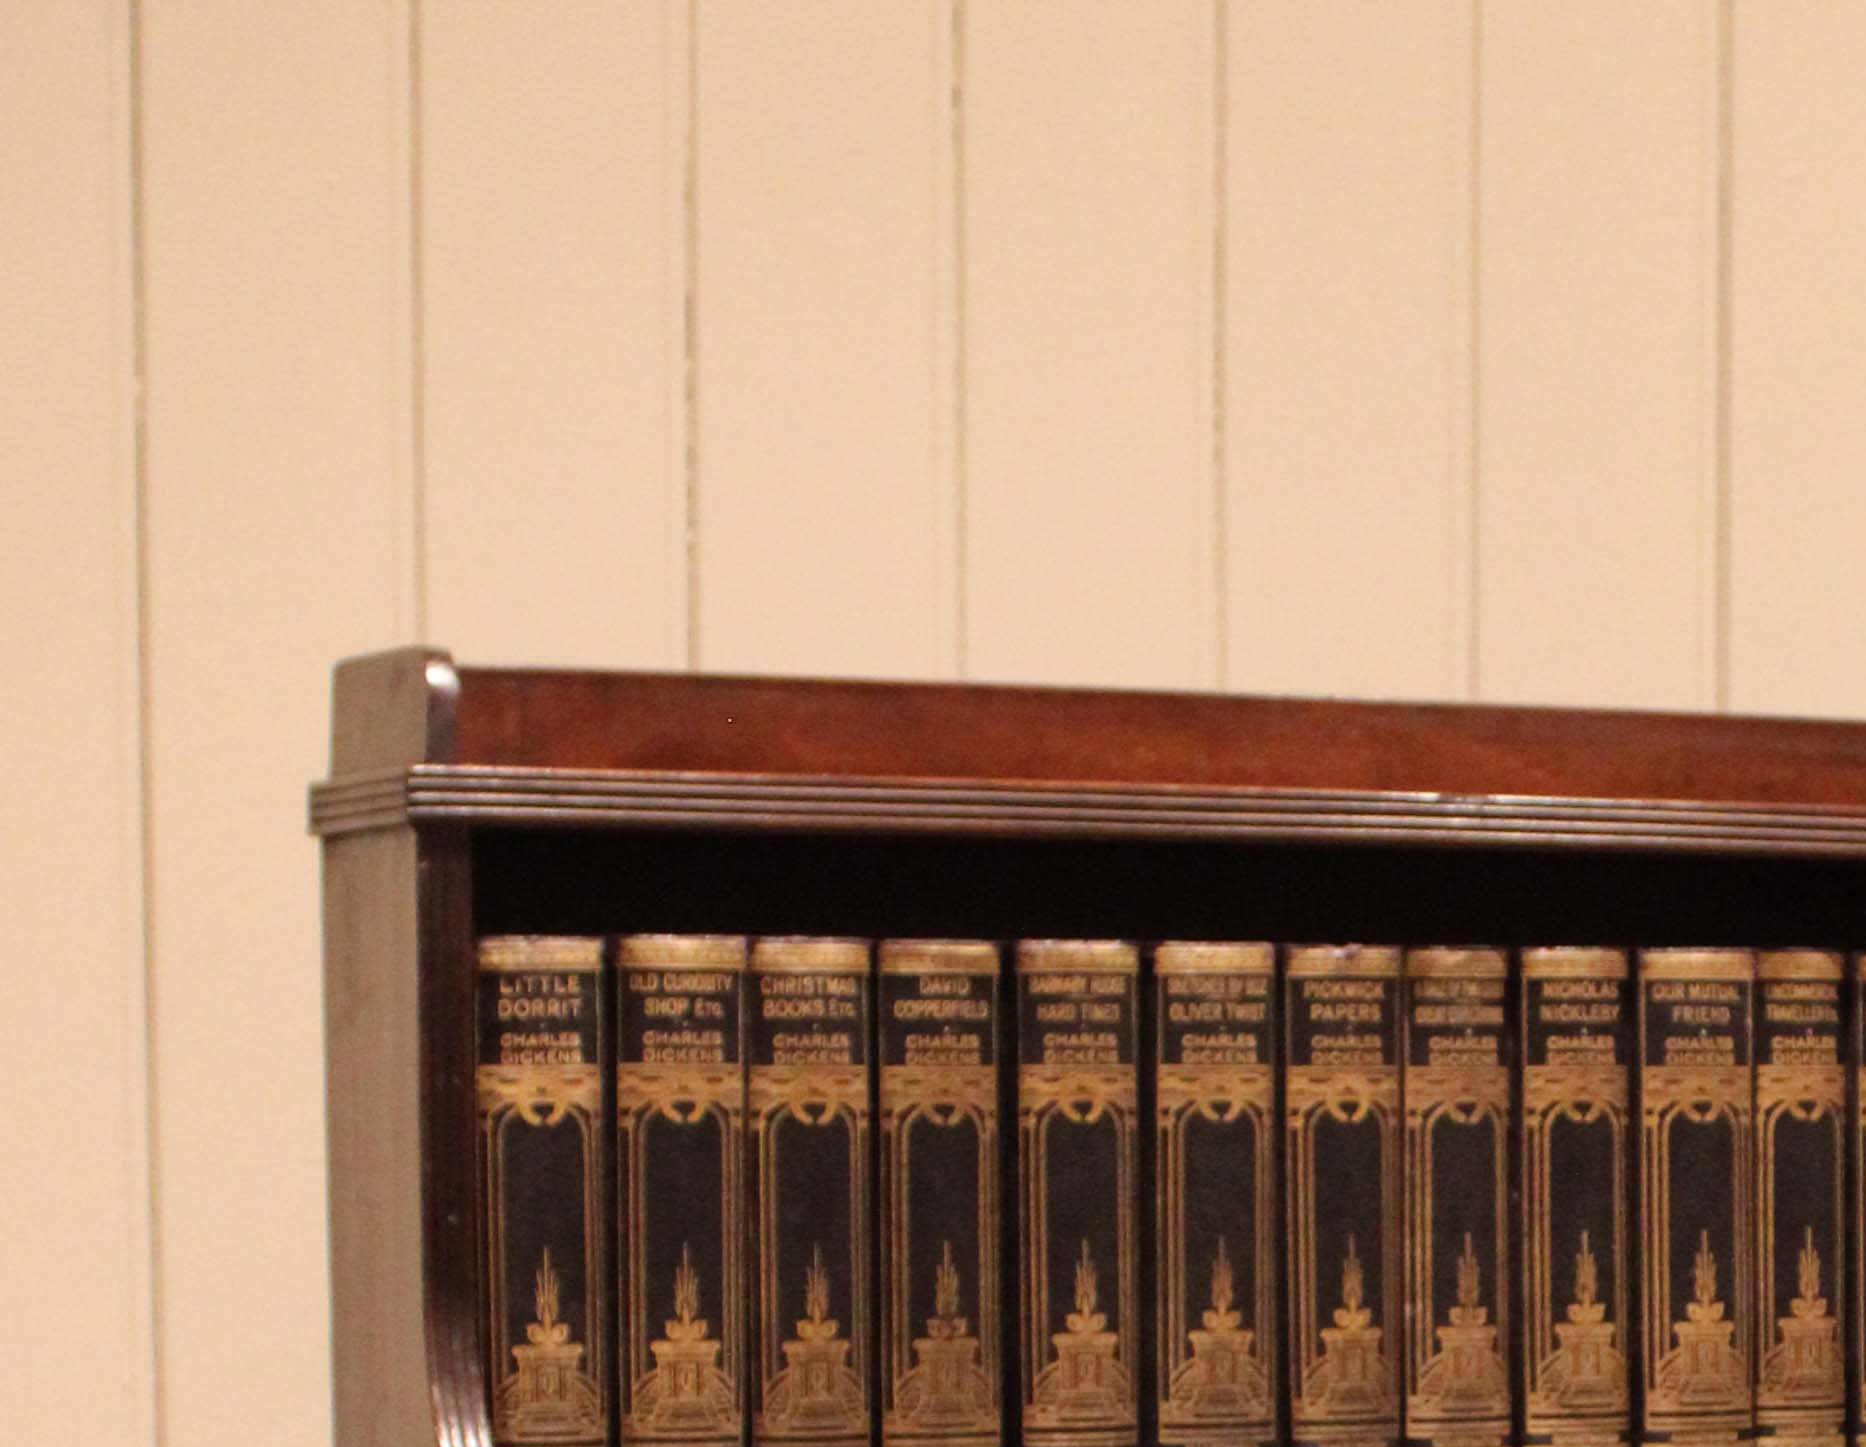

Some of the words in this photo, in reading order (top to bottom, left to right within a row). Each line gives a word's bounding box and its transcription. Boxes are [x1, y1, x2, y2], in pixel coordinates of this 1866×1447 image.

[499, 974, 579, 994] LITTLE
[919, 976, 971, 995] DAVID
[1542, 981, 1619, 999] NICHOLAS
[1652, 983, 1685, 1000] OUR
[498, 998, 581, 1018] DORRIT
[643, 998, 689, 1018] SHOP
[763, 1000, 824, 1019] BOOKS
[894, 1000, 989, 1019] COPPERFIELD
[1310, 1003, 1382, 1022] PAPERS
[1540, 1004, 1621, 1021] NICKLEBY
[1672, 1006, 1731, 1023] FRIEND
[500, 1032, 580, 1049] CHARLES
[642, 1031, 722, 1047] CHARLES
